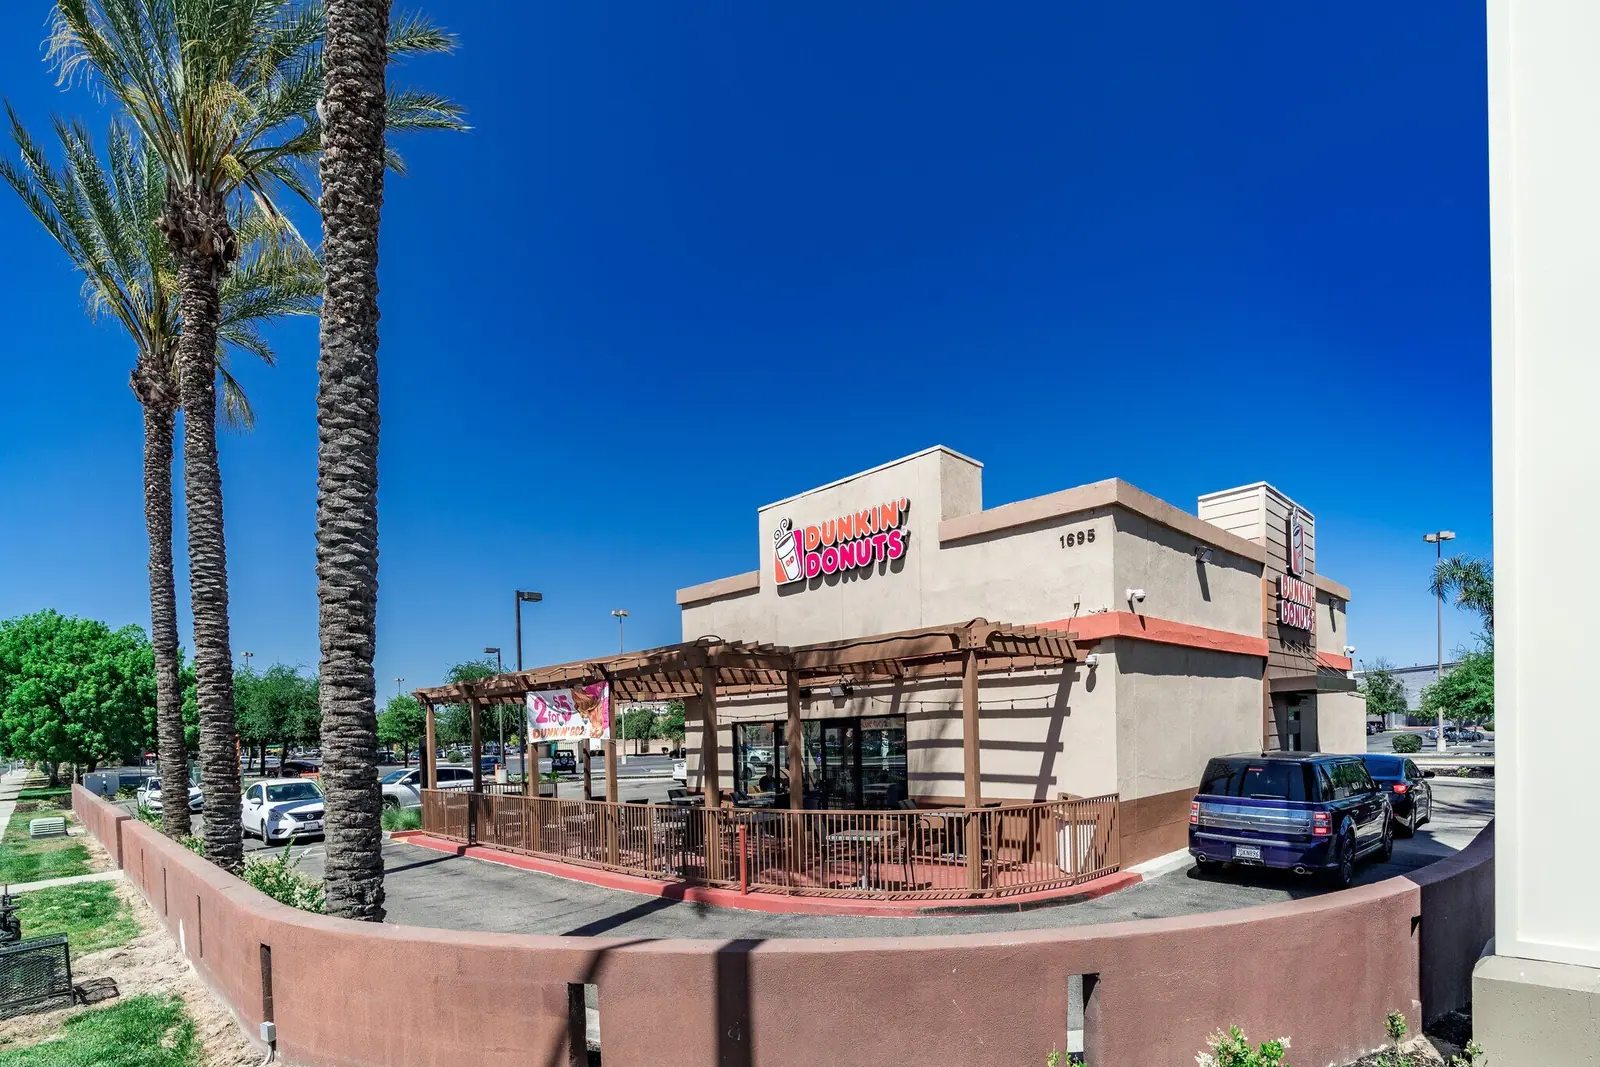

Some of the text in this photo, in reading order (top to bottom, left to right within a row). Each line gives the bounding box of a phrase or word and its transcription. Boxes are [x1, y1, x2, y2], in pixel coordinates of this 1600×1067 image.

[804, 497, 908, 551] DUNKIN'
[1060, 528, 1096, 549] 1695
[805, 529, 904, 579] DONUTS
[1281, 599, 1314, 632] DONUTS
[534, 696, 548, 724] 2
[548, 711, 561, 723] for
